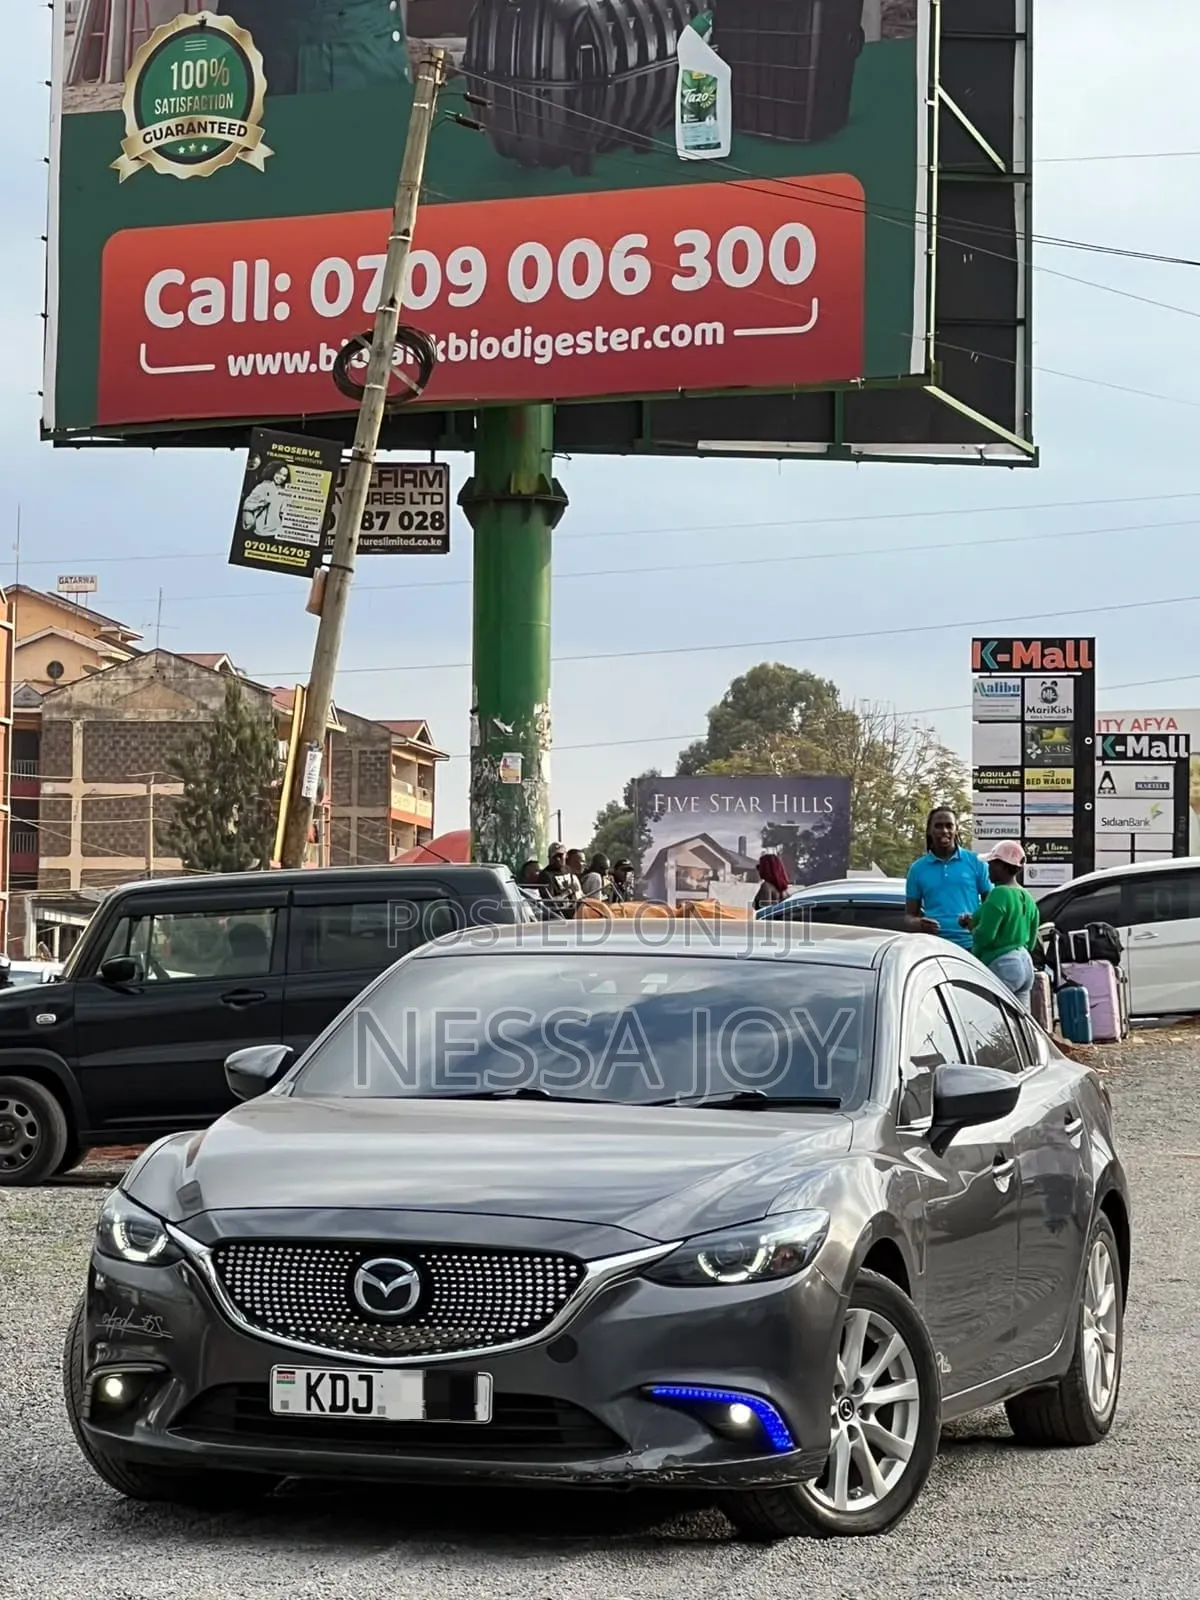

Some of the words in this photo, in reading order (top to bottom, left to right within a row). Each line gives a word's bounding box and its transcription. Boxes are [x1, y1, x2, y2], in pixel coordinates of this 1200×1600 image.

[170, 57, 230, 91] 100%
[154, 93, 234, 115] SATISFACTION
[142, 121, 248, 145] GUARANTEED
[144, 258, 291, 329] Call:
[310, 246, 487, 318] 0709
[507, 233, 651, 303] 006
[671, 222, 816, 292] 300
[271, 443, 321, 458] PROSERVE
[409, 491, 444, 505] LTD
[398, 510, 445, 531] 028
[244, 540, 311, 558] 0701414705
[972, 640, 1092, 669] K-Mall
[1026, 705, 1072, 714] MariKish
[1130, 717, 1178, 731] AFYA
[1096, 735, 1188, 757] K-Mall
[1043, 777, 1072, 785] WAGON
[654, 793, 700, 813] FIVE
[710, 793, 763, 813] STAR
[772, 793, 834, 813] HILLS
[974, 827, 1019, 835] UNIFORMS
[305, 1372, 374, 1414] KDJ
